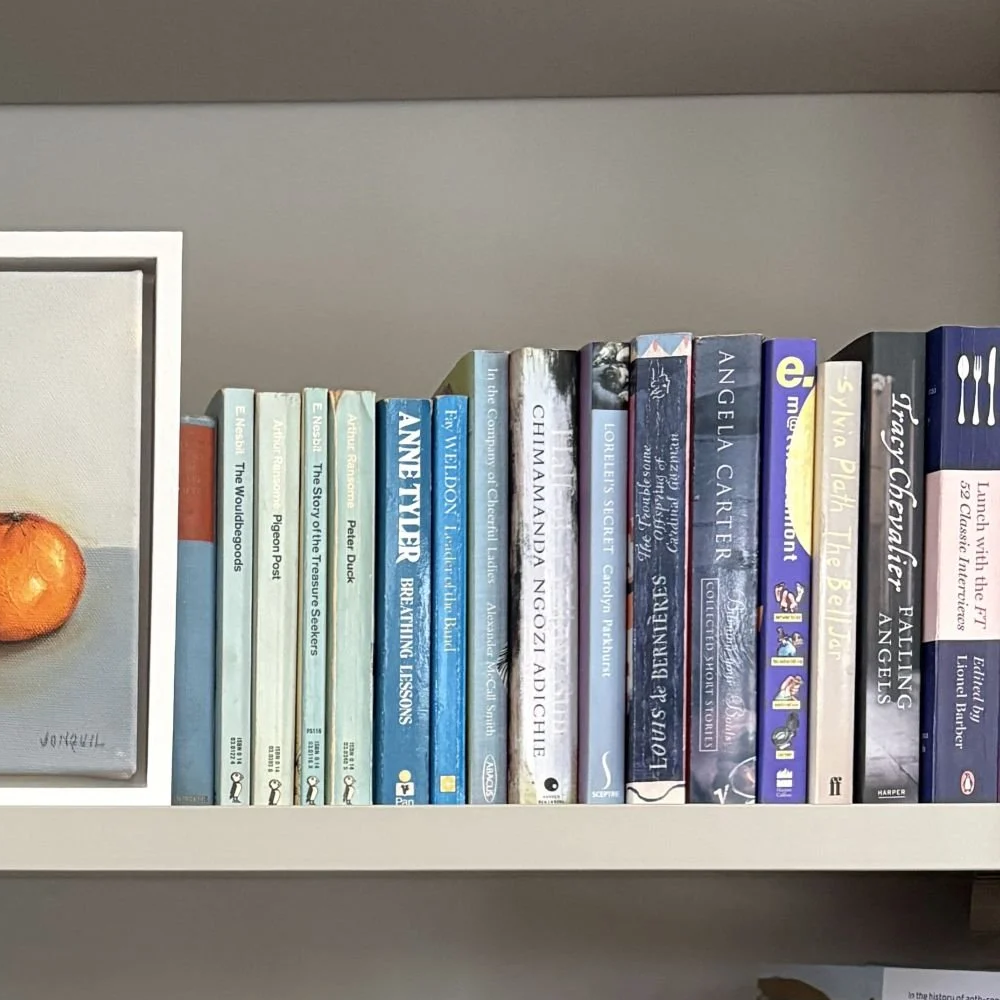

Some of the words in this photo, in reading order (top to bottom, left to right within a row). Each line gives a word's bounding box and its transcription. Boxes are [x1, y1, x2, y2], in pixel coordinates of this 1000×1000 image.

[442, 409, 458, 433] Fay
[716, 351, 735, 452] ANGELA
[398, 411, 421, 479] ANNE
[485, 408, 497, 467] Company
[881, 393, 919, 464] Tracy
[443, 436, 458, 515] WELDON
[603, 423, 615, 493] LORELEI'S
[829, 457, 856, 512] Plath
[532, 404, 545, 568] CHIMAMANDA
[635, 445, 653, 530] Troublesome
[652, 475, 666, 541] Offspring
[975, 482, 989, 531] Lunch
[233, 486, 244, 572] Wouldbegoods
[271, 514, 283, 552] Pigeon
[346, 520, 357, 551] Peter
[396, 483, 421, 564] TYLER
[487, 489, 498, 540] Cheerful
[603, 500, 615, 554] SECRET
[667, 497, 680, 554] Cardinal
[713, 464, 733, 565] CARTER
[887, 468, 918, 592] Chevalier
[959, 503, 971, 553] Classic
[346, 554, 357, 584] Duck
[444, 525, 458, 575] Leader
[487, 547, 498, 584] Ladies
[826, 527, 852, 568] The
[975, 537, 989, 571] with
[311, 554, 322, 607] Treasure
[600, 564, 614, 613] Carolyn
[825, 577, 851, 623] Bell
[956, 556, 970, 631] Interviews
[975, 576, 988, 600] the
[310, 608, 320, 656] Seekers
[399, 577, 414, 659] BREATHING
[443, 617, 457, 652] Band
[486, 602, 497, 657] Alexander
[532, 579, 546, 653] NGOZI
[704, 581, 714, 651] COLLECTED
[974, 606, 987, 629] FT
[601, 620, 613, 677] Parkhurst
[828, 626, 849, 660] Jar
[877, 612, 892, 705] ANGELS
[896, 606, 913, 710] FALLING
[398, 665, 412, 725] LESSONS
[704, 656, 713, 695] SHORT
[955, 655, 968, 698] Lionel
[972, 656, 985, 701] Edited
[486, 704, 496, 736] Smith
[532, 662, 546, 758] ADICHIE
[703, 700, 713, 748] STORIES
[954, 703, 967, 749] Barber
[40, 731, 105, 753] JONQUIL
[649, 710, 668, 770] LOUIS
[592, 790, 619, 798] SCEPTRE
[916, 992, 928, 1000] the
